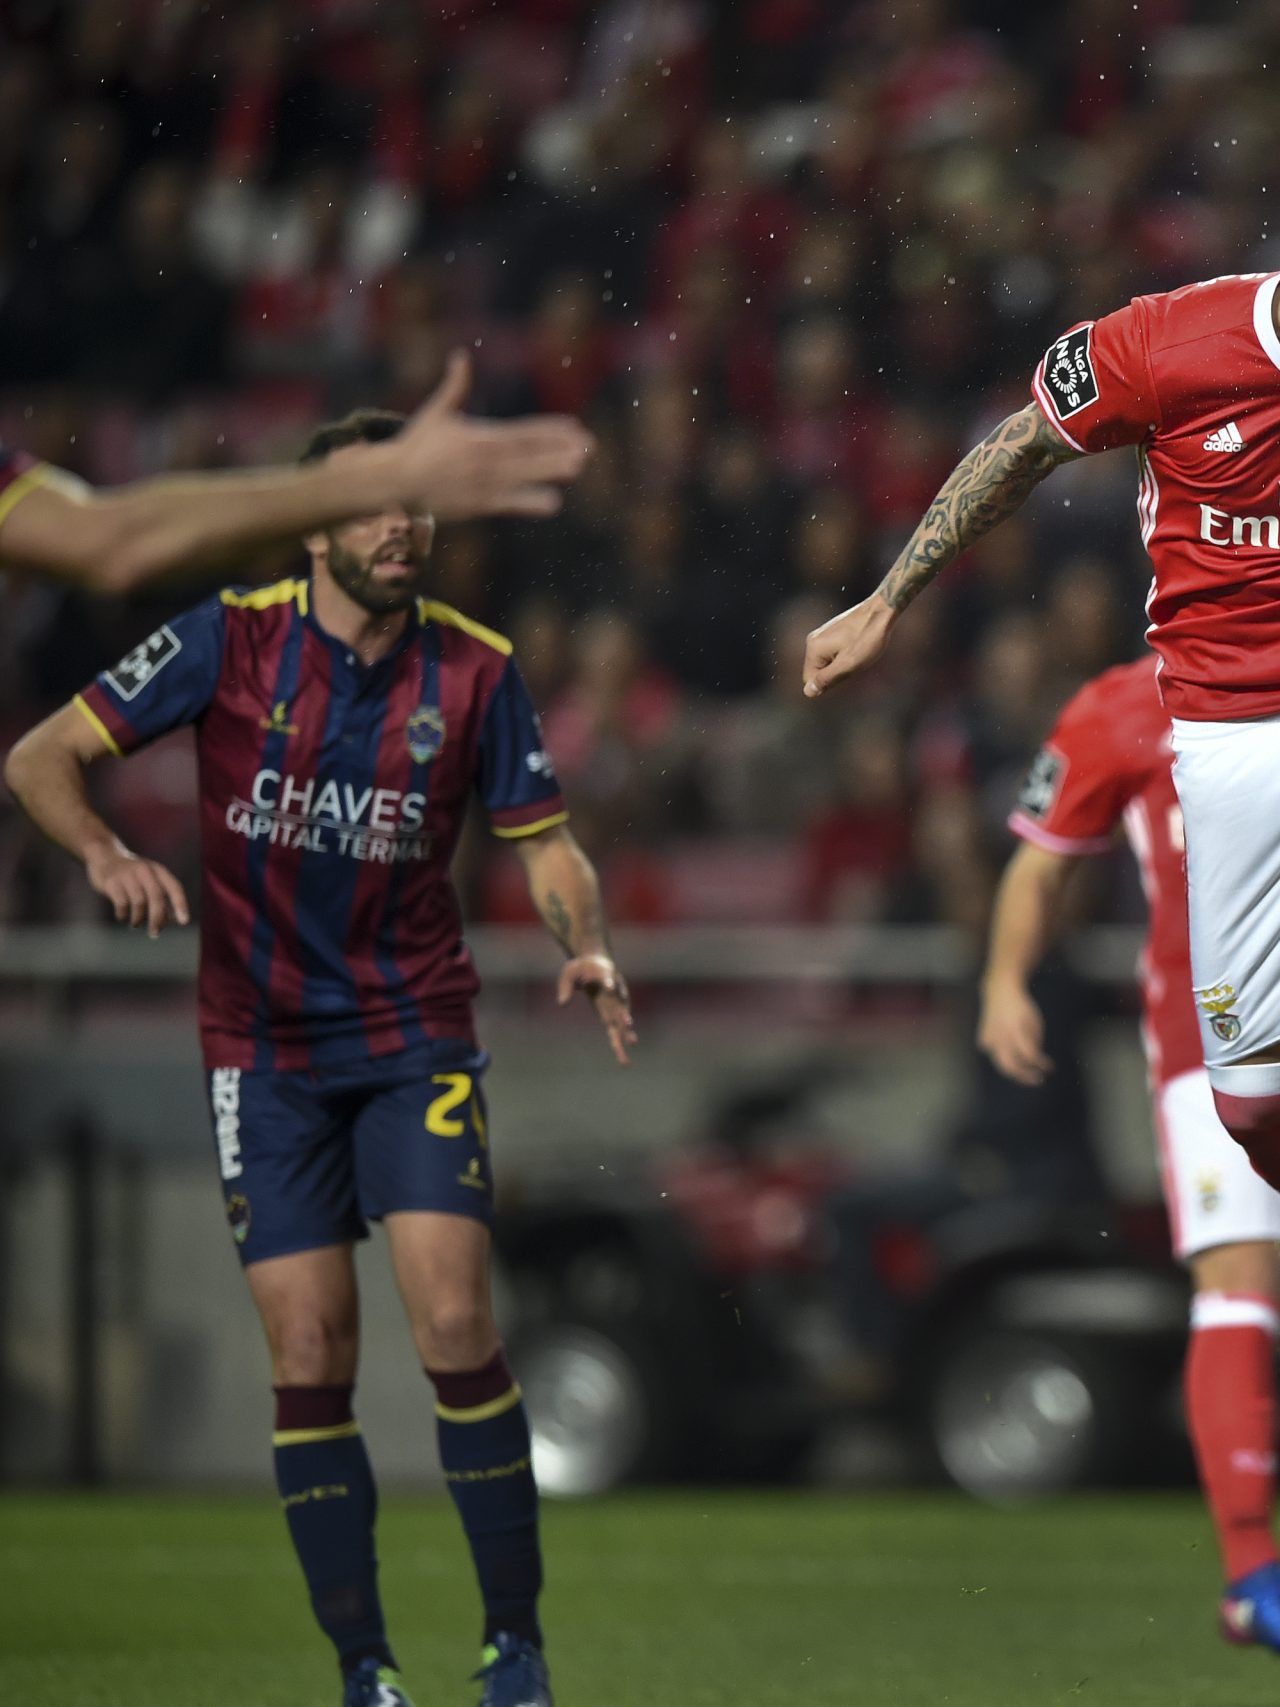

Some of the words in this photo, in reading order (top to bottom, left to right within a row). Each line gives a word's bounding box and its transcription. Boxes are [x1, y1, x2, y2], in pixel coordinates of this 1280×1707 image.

[1050, 340, 1080, 407] NOS
[1074, 345, 1089, 383] LIGA
[225, 802, 328, 853] CAPITAL
[252, 768, 427, 833] CHAVES
